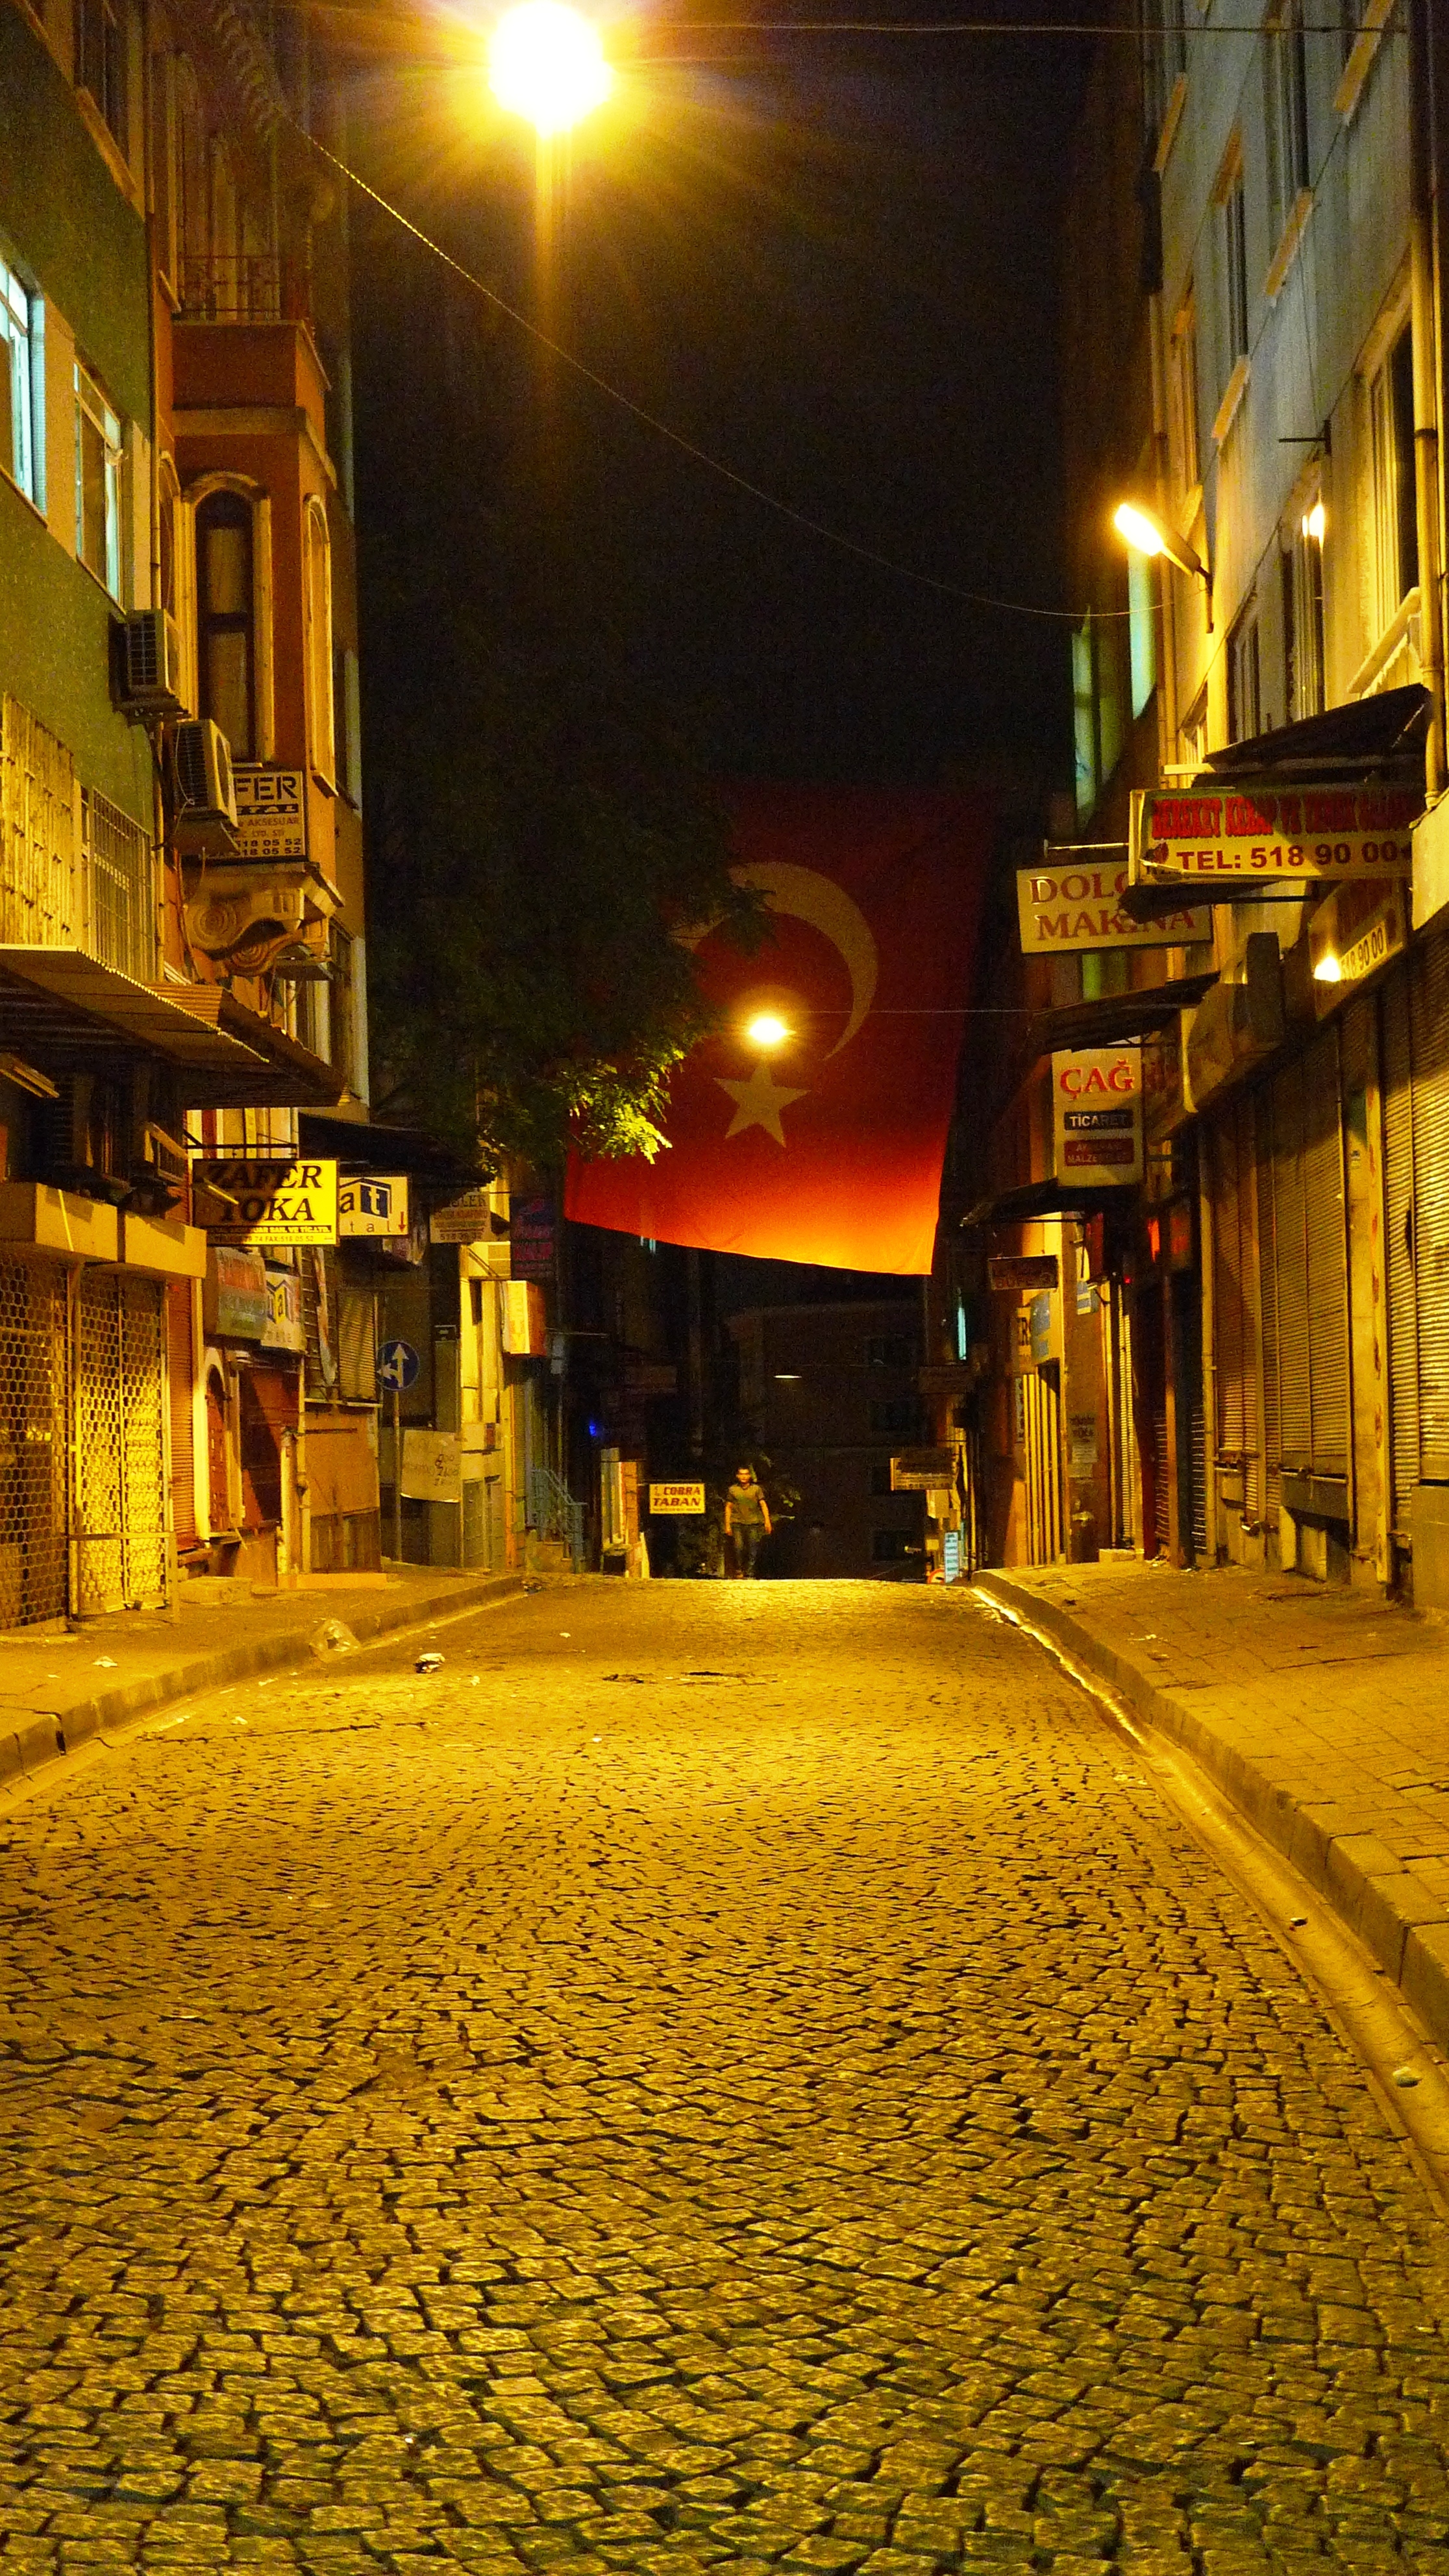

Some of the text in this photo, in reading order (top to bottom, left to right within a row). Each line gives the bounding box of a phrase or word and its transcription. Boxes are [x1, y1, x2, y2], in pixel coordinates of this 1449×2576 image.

[1176, 840, 1397, 871] TEL: 518 90 00
[1035, 908, 1196, 941] MAKNA
[1357, 939, 1370, 971] 90
[1371, 926, 1384, 960] 00
[1060, 1058, 1135, 1100] ÇAĞ
[1069, 1113, 1127, 1128] TİCARET
[208, 1165, 322, 1189] ZAFER
[653, 1498, 701, 1506] TABAN
[663, 1487, 700, 1495] COBRA
